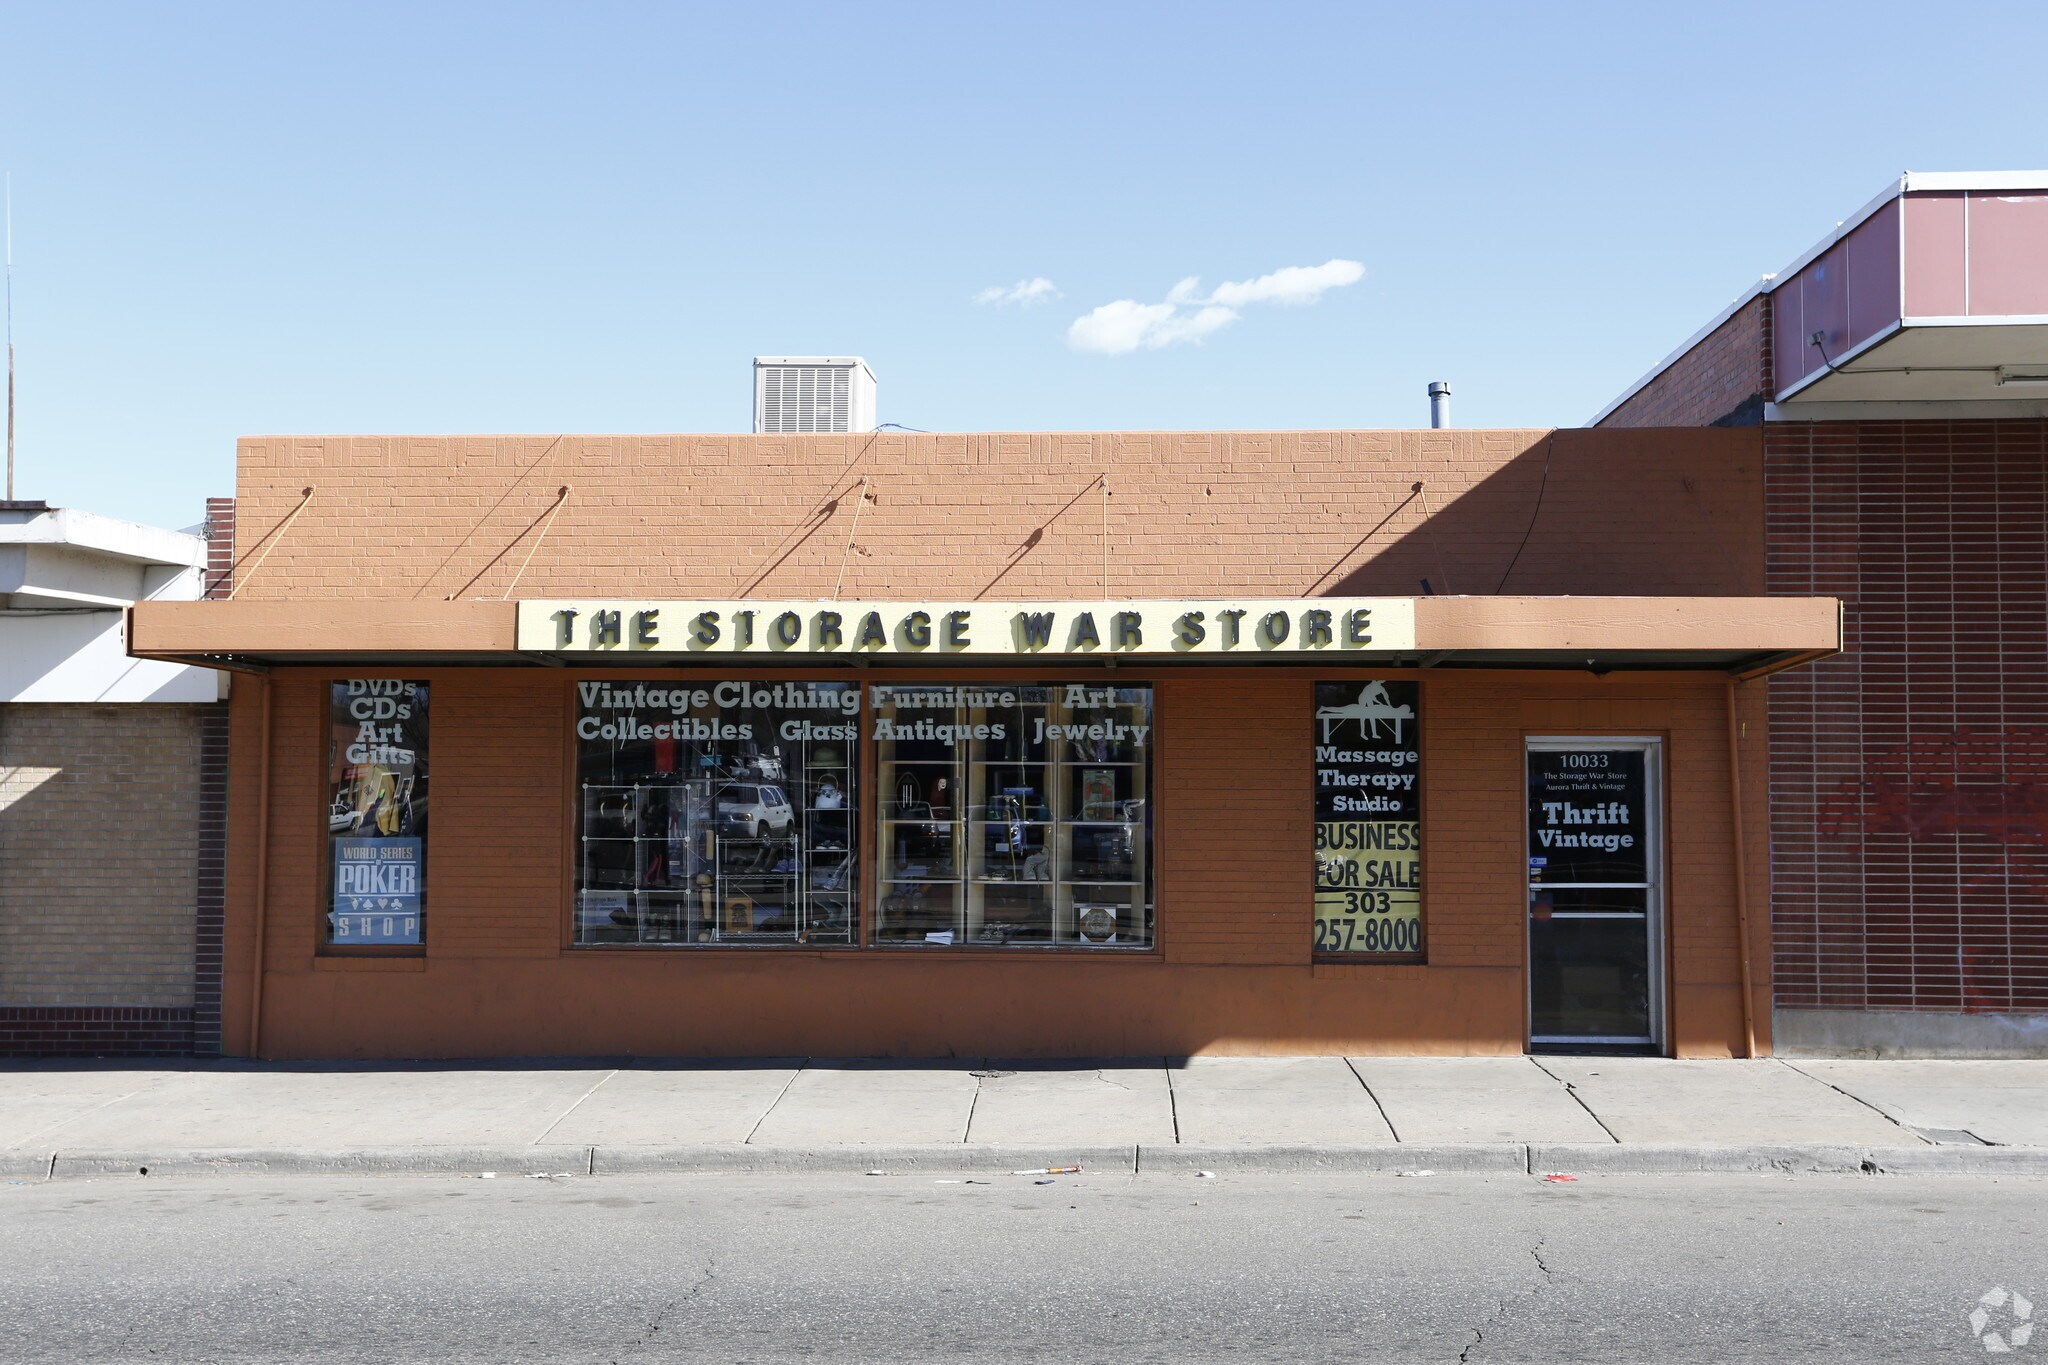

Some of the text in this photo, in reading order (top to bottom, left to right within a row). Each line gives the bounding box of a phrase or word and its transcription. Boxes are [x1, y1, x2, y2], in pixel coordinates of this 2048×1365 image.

[559, 608, 1372, 646] THE STORAGE WAR STORE
[347, 679, 417, 697] DVDs
[578, 681, 862, 715] Vintage Clothing
[872, 686, 1016, 709] Furniture
[1062, 684, 1116, 709] Art
[350, 698, 411, 719] CDs
[355, 721, 403, 743] Art
[577, 716, 858, 741] Collectibles Glass
[872, 718, 1150, 747] Antiques Jewelry
[346, 744, 413, 765] Gifts
[1315, 746, 1418, 767] Massage
[1560, 754, 1609, 768] 10033
[1318, 769, 1415, 791] Therapy
[1544, 772, 1627, 781] The Storage War Store
[1571, 783, 1590, 791] Thrift
[1591, 783, 1598, 791] &
[1599, 783, 1626, 792] Vintage
[1333, 795, 1401, 812] Studio
[1543, 802, 1629, 825] Thrift
[1315, 823, 1420, 851] BUSINESS
[1537, 830, 1634, 852] Vintage
[343, 847, 413, 859] WORLD SERIES
[339, 865, 416, 894] POKER
[1365, 860, 1420, 888] SALE
[1344, 892, 1391, 914] 303
[339, 917, 415, 936] SHOP
[1315, 917, 1420, 951] 257-8000
